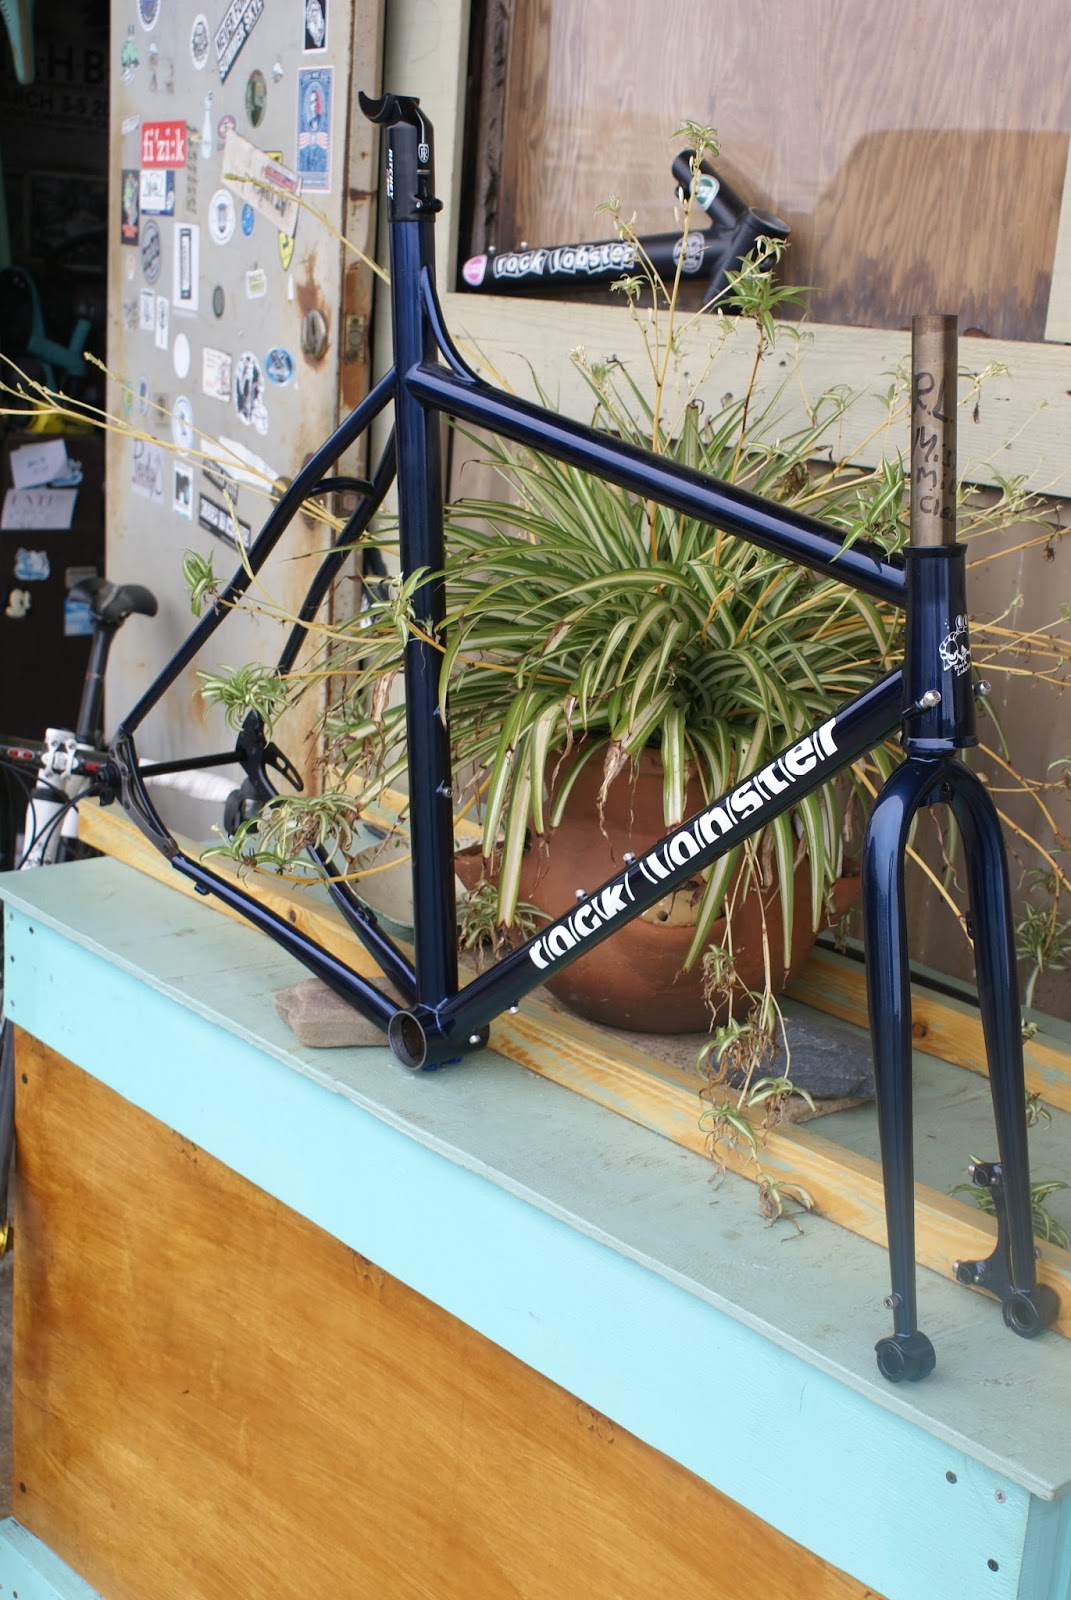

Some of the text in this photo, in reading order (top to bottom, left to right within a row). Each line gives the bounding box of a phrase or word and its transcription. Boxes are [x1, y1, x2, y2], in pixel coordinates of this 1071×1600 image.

[493, 250, 549, 277] rock
[529, 718, 839, 970] rock lobster
